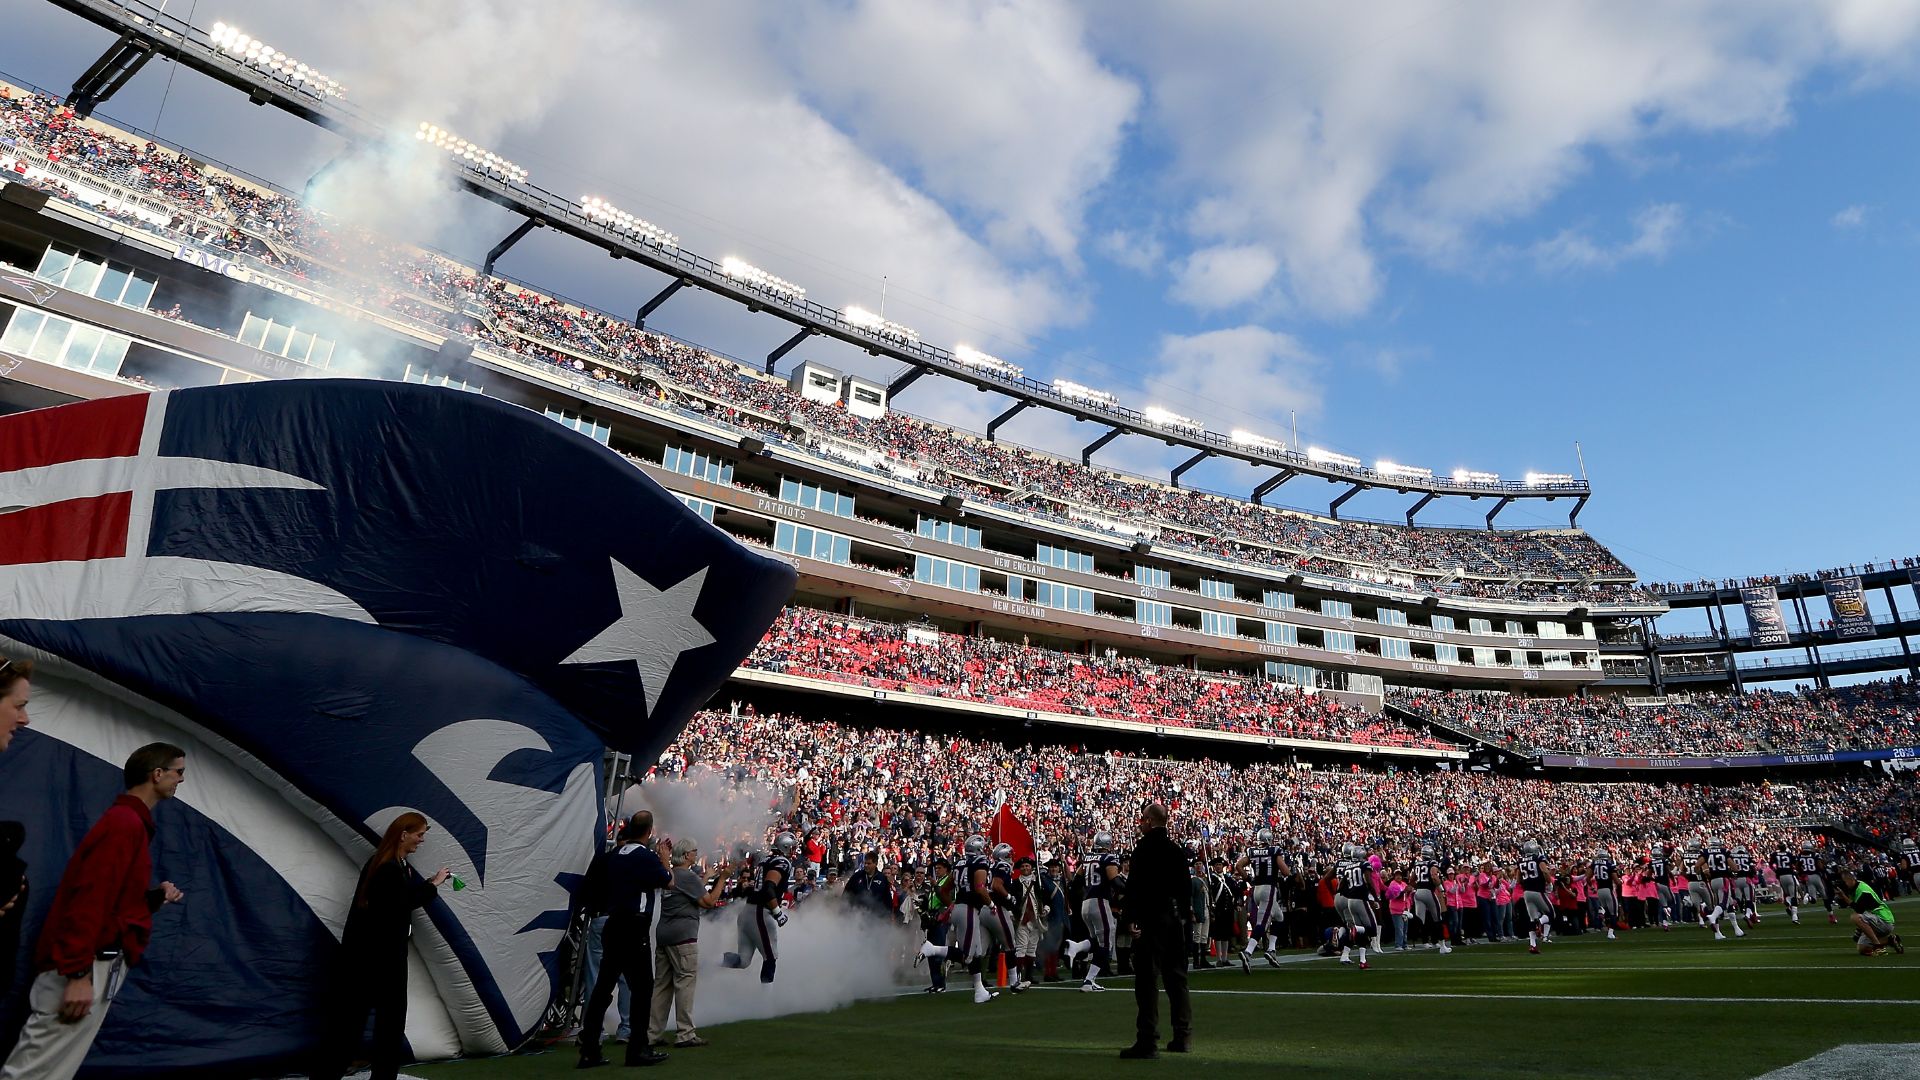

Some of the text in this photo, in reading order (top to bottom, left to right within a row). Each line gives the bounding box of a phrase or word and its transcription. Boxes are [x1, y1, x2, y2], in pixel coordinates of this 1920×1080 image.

[758, 499, 806, 520] PATRIOTS
[994, 556, 1046, 576] NEW ENGLAND
[992, 600, 1046, 618] NEW ENGLAND
[1256, 608, 1286, 619] PATRIOTS
[1843, 626, 1869, 635] 2003
[1760, 635, 1782, 643] 2001
[1258, 643, 1289, 656] PATRIOTS
[1650, 759, 1681, 767] PATRIOTS
[1784, 753, 1835, 763] NEW ENGLAND
[1250, 857, 1272, 876] 77
[1707, 854, 1727, 871] 43
[1776, 855, 1790, 868] 12
[1083, 862, 1102, 887] 76
[1344, 867, 1363, 889] 30
[1415, 865, 1429, 882] 92
[1519, 861, 1538, 880] 59
[1593, 865, 1609, 880] 46
[1652, 863, 1664, 877] 17
